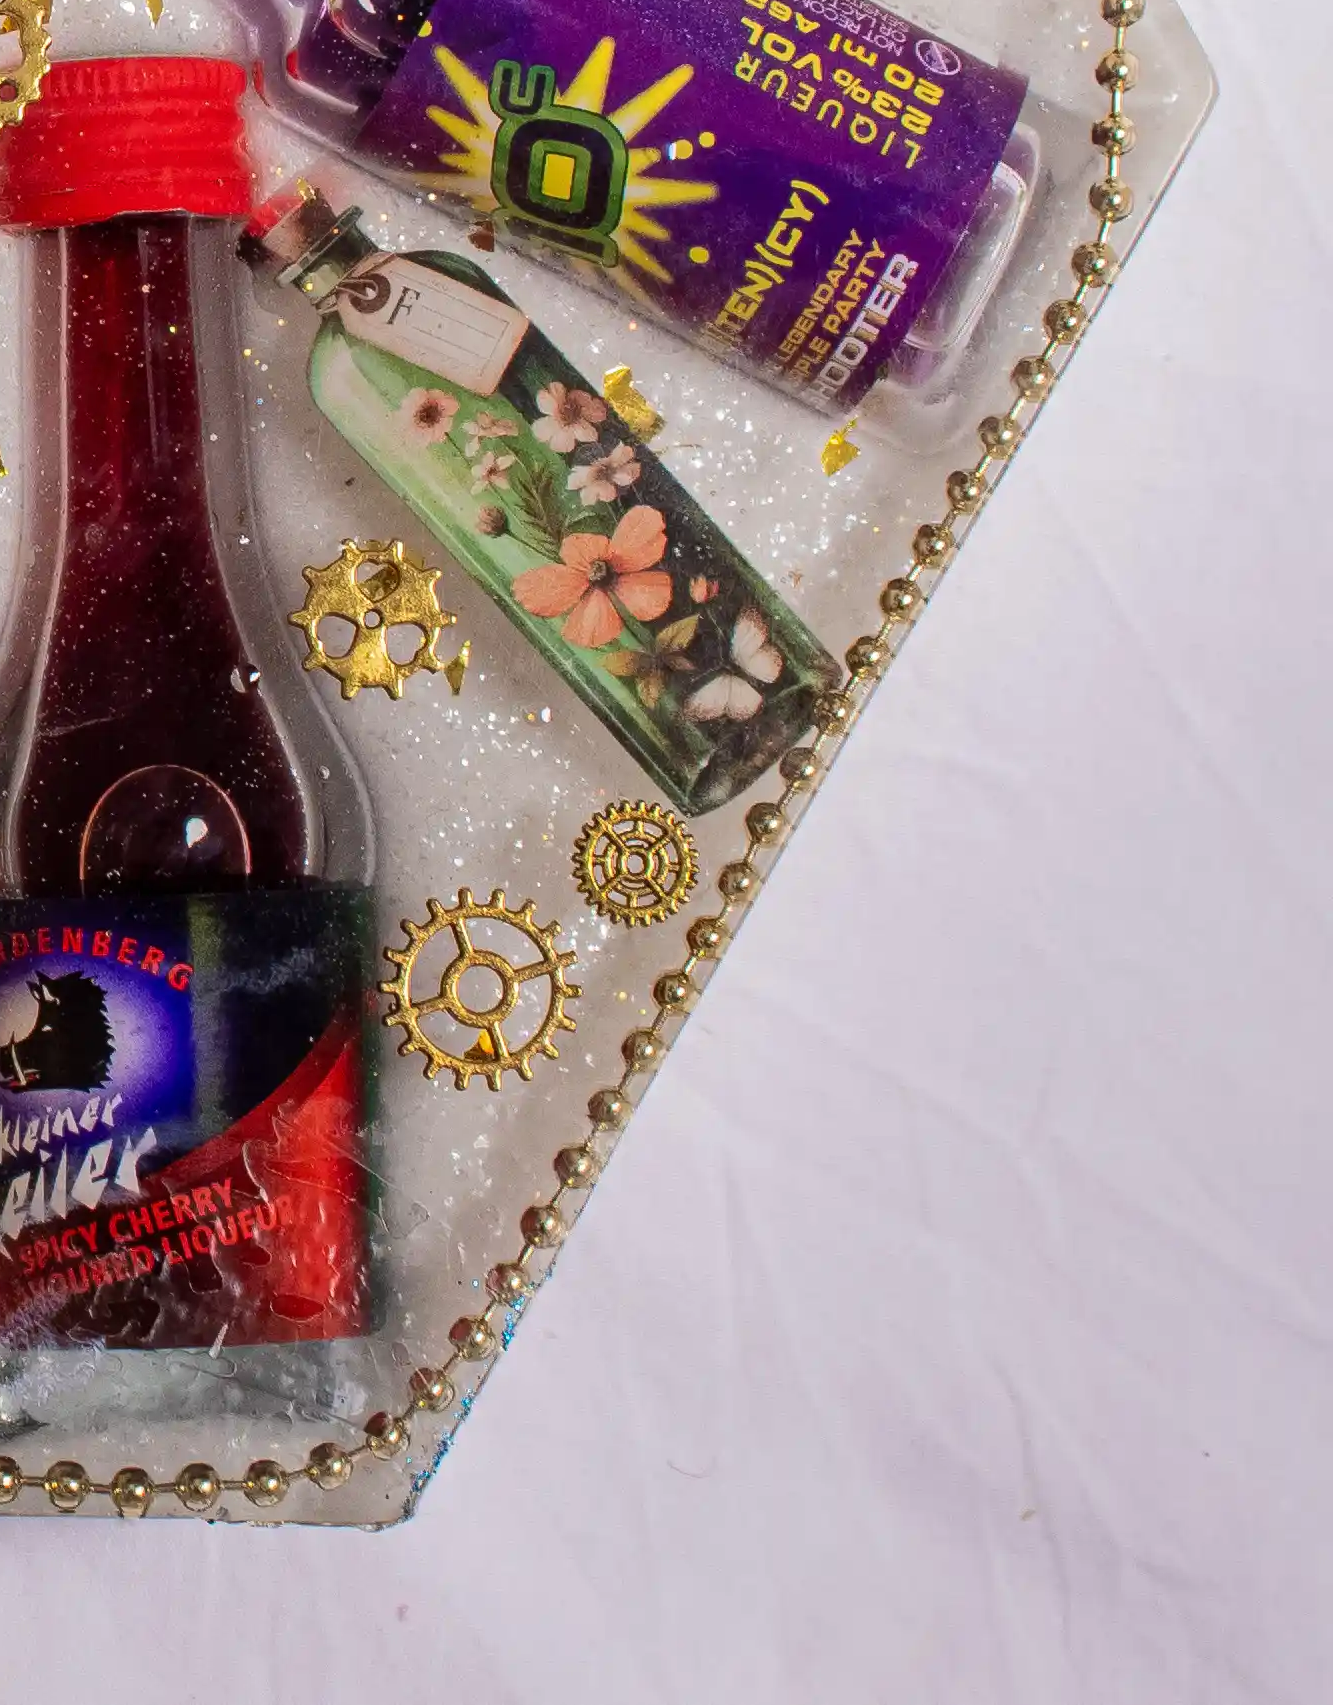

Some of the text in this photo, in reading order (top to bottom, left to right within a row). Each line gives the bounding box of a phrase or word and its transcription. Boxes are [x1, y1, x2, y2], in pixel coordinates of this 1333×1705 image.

[733, 14, 934, 137] 23% VOL
[826, 31, 879, 71] ml
[861, 27, 904, 56] NOT
[880, 60, 945, 108] 20
[731, 49, 923, 170] LIQUEUR
[386, 285, 421, 325] F
[778, 227, 866, 362] LEGENDARY
[822, 239, 892, 335] PARTY
[19, 1177, 237, 1275] SPICY CHERRY
